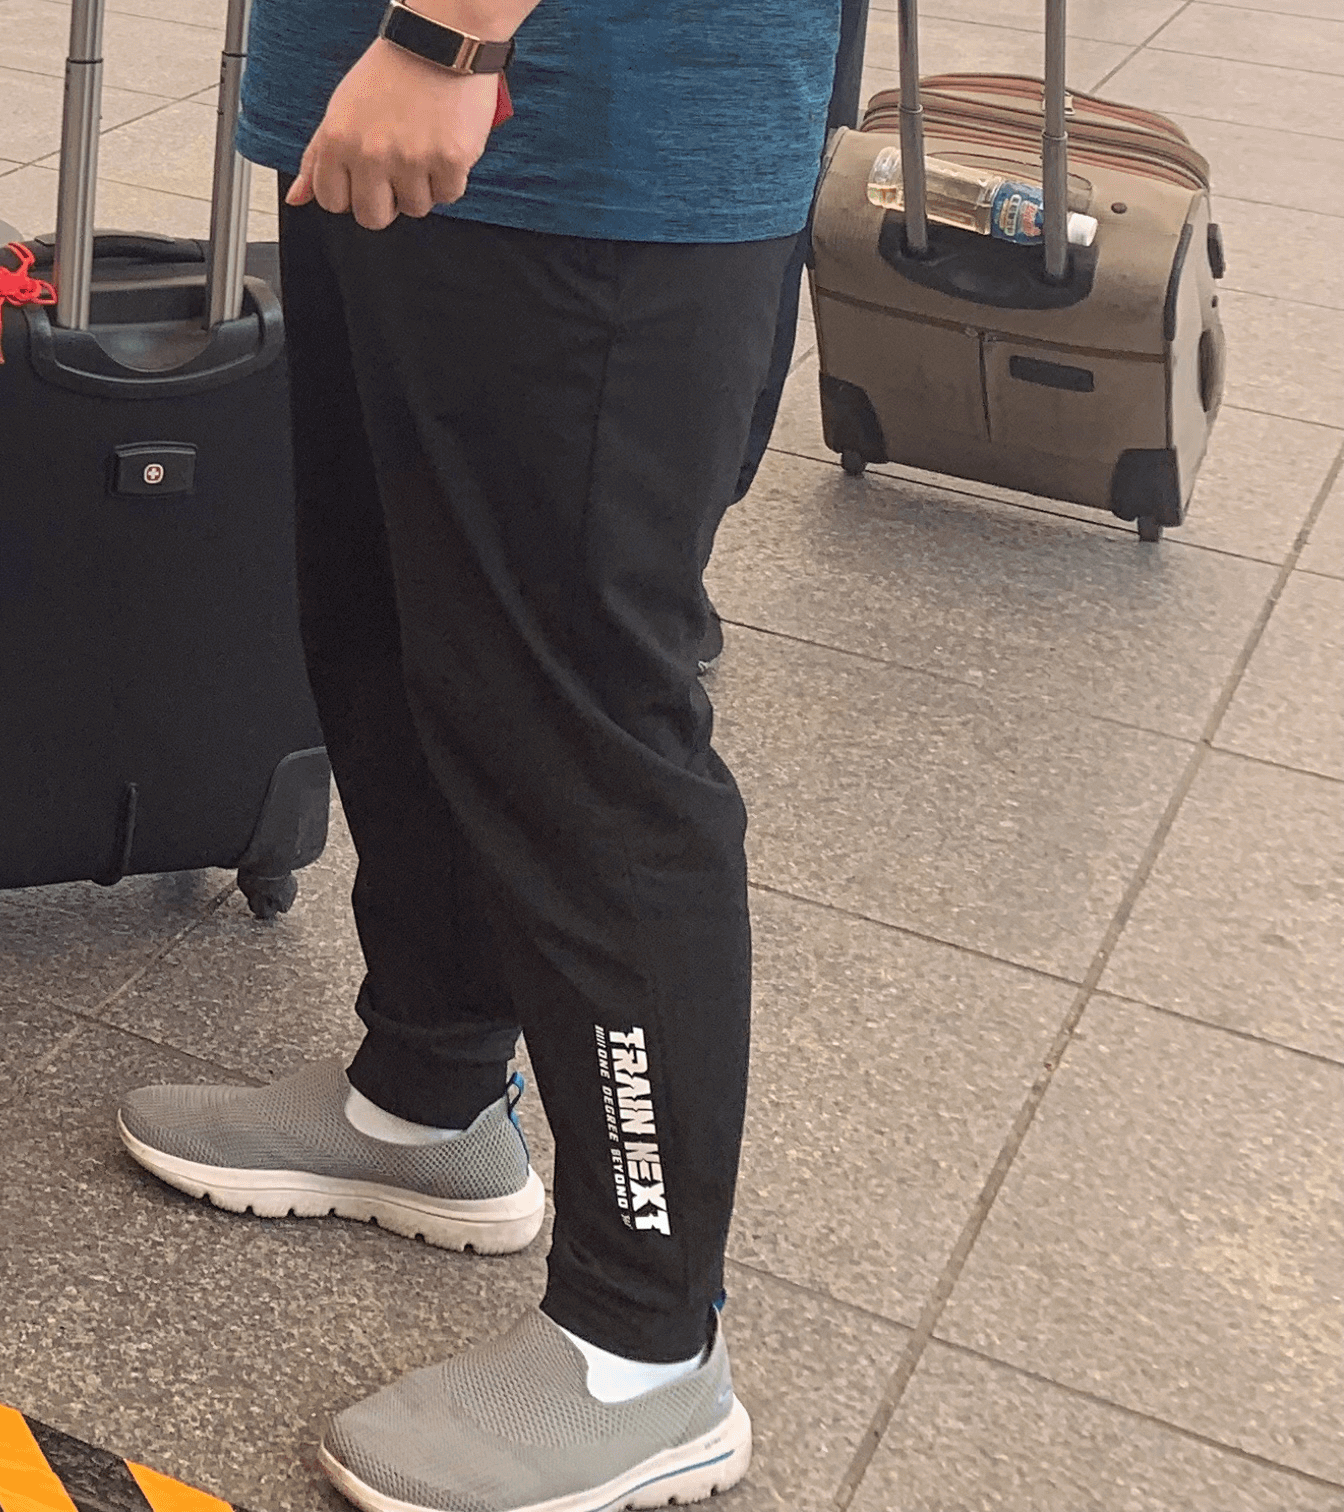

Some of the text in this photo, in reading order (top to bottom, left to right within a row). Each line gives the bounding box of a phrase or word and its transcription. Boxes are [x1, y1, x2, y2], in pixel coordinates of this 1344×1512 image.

[597, 1049, 611, 1079] ONE
[602, 1086, 619, 1142] DEGREE
[609, 1026, 671, 1236] TRAIN NEXT
[610, 1148, 629, 1210] BEYOND
